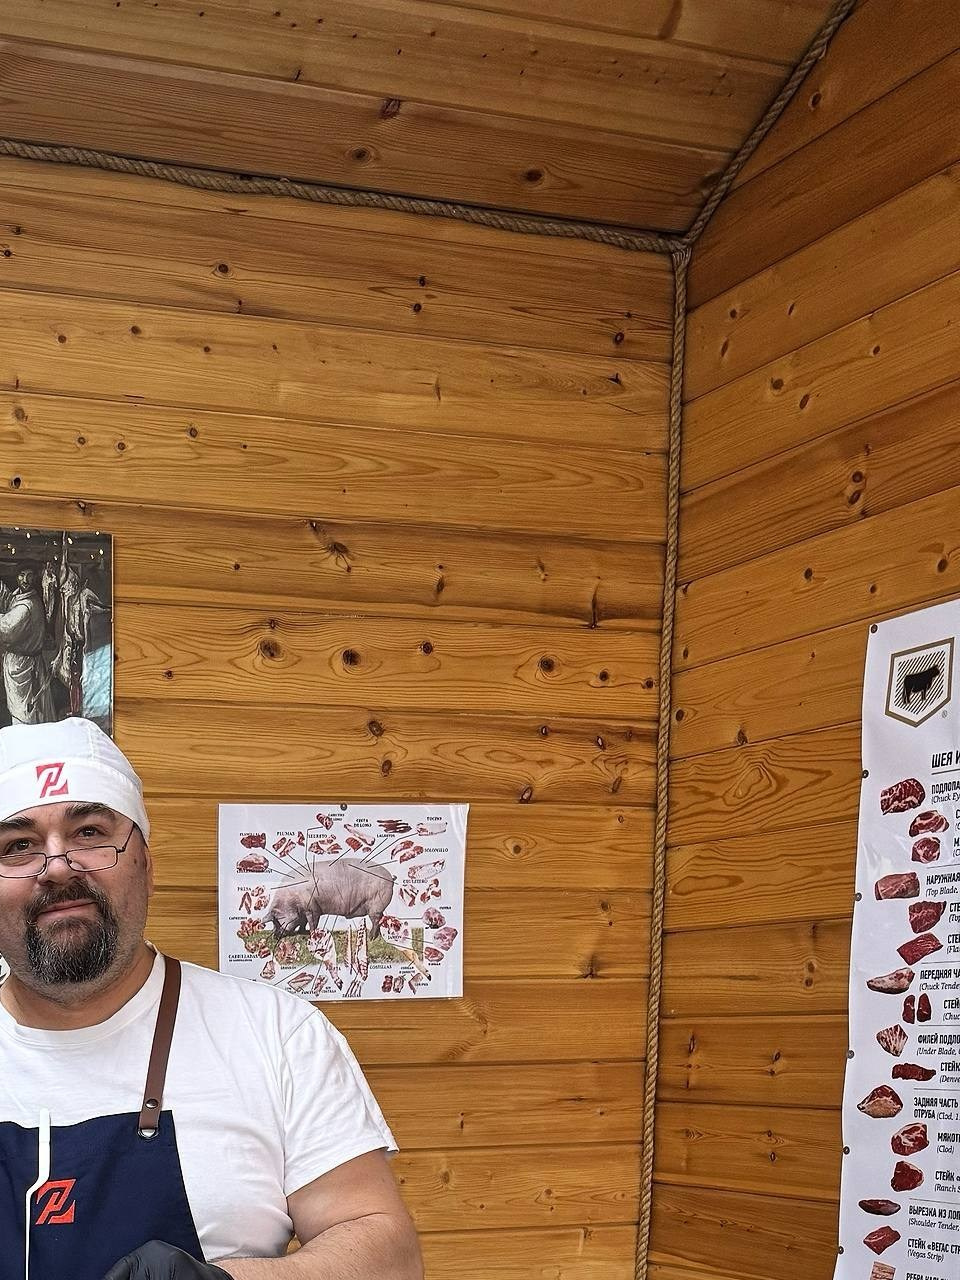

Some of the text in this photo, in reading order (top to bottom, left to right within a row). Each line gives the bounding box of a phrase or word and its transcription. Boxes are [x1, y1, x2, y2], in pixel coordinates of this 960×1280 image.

[932, 752, 952, 768] ШЕЯ
[920, 969, 952, 981] ПЕРЕДНЯЯ
[918, 1033, 938, 1044] ФИЛЕЙ
[914, 1097, 959, 1108] ЗАДНЯЯ ЧАСТЬ
[914, 1109, 935, 1119] ОТРУБА
[937, 1146, 954, 1154] (Clod)
[935, 1170, 954, 1181] СТЕЙК
[909, 1205, 936, 1217] ВЫРЕЗКА
[938, 1209, 946, 1219] ИЗ
[909, 1218, 936, 1228] (Shoulder
[908, 1238, 926, 1250] СТЕЙК
[907, 1249, 944, 1263] (Vegas Strip)
